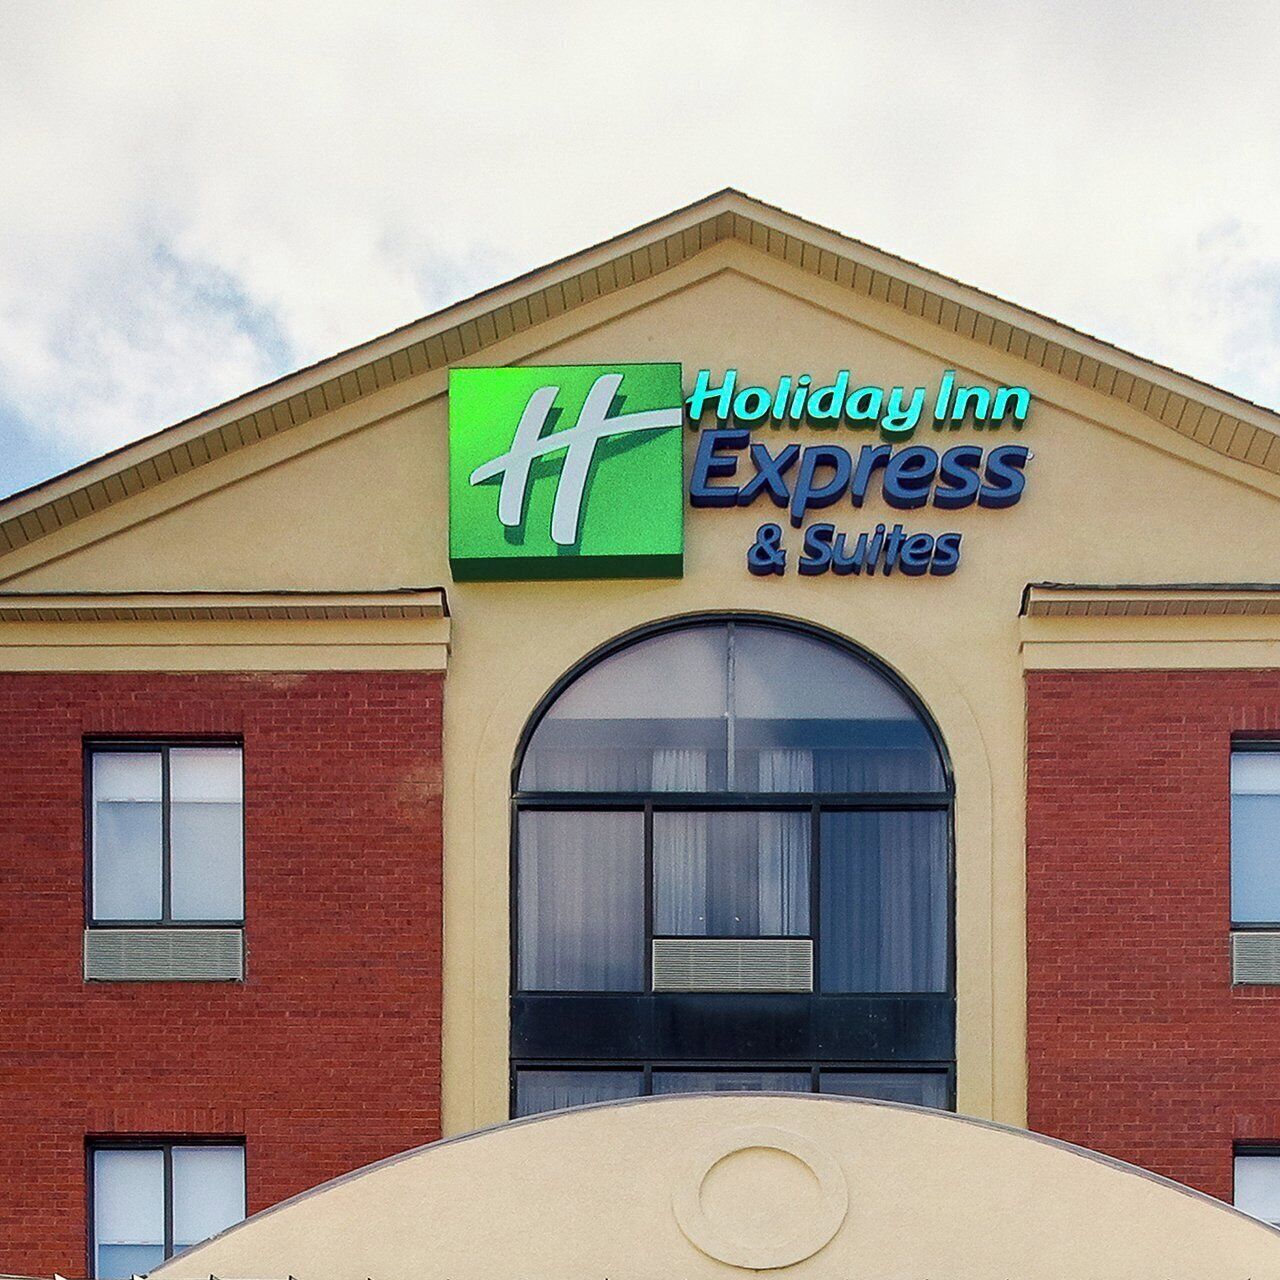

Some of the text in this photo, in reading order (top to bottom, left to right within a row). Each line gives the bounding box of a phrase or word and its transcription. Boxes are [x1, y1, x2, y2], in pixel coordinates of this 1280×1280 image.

[686, 368, 1031, 434] Holiday Inn
[470, 374, 682, 545] H
[689, 428, 1030, 528] Express
[747, 522, 963, 577] & Suites
